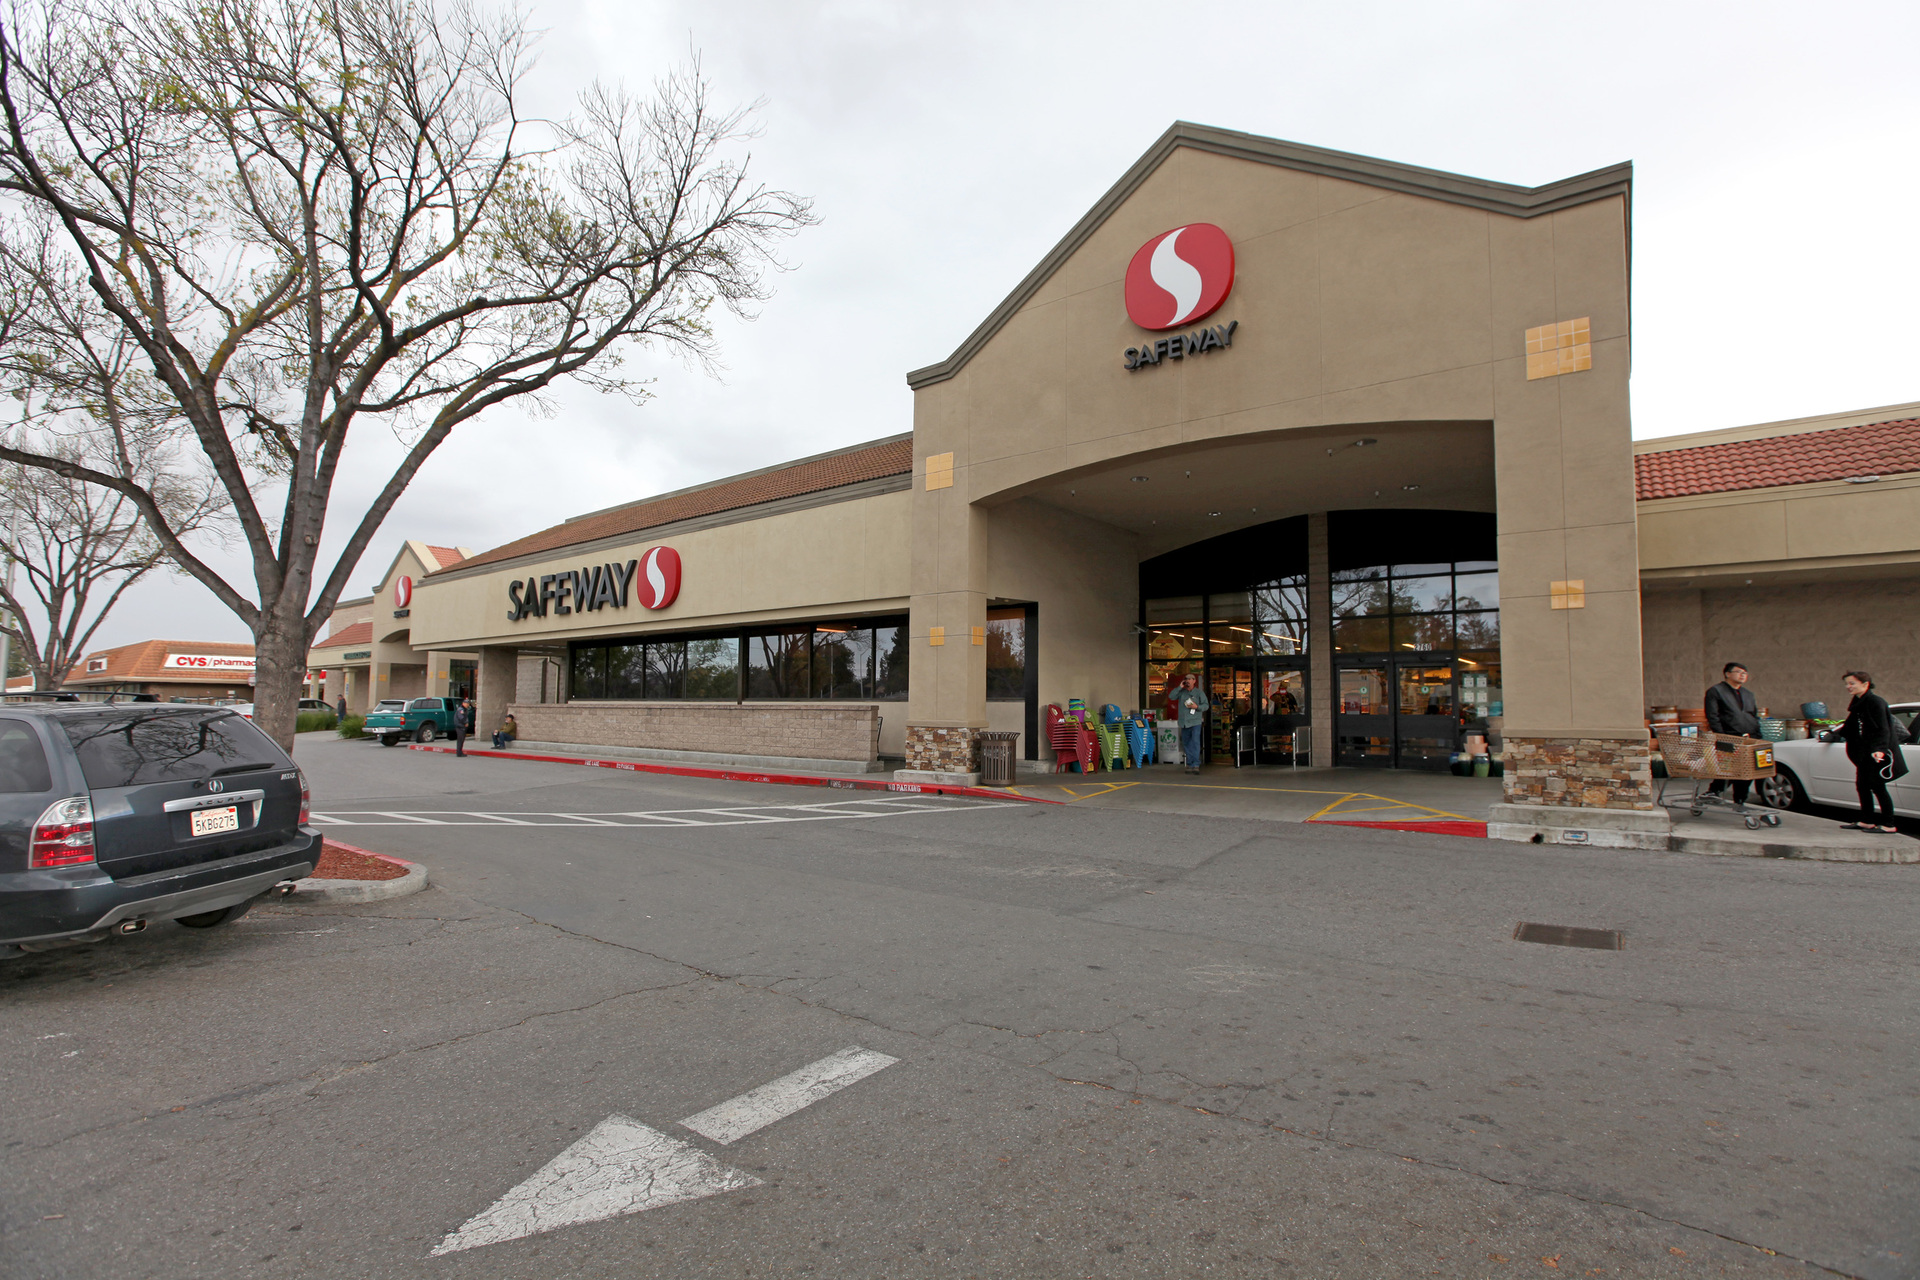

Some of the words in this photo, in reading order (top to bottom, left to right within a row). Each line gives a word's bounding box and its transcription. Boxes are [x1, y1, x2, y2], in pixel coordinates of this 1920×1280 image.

[1123, 320, 1239, 371] SAFEWAY
[507, 559, 637, 621] SAFEWAY
[896, 784, 921, 793] PARKING
[195, 796, 244, 806] ACURA
[195, 814, 236, 832] 5KBG275
